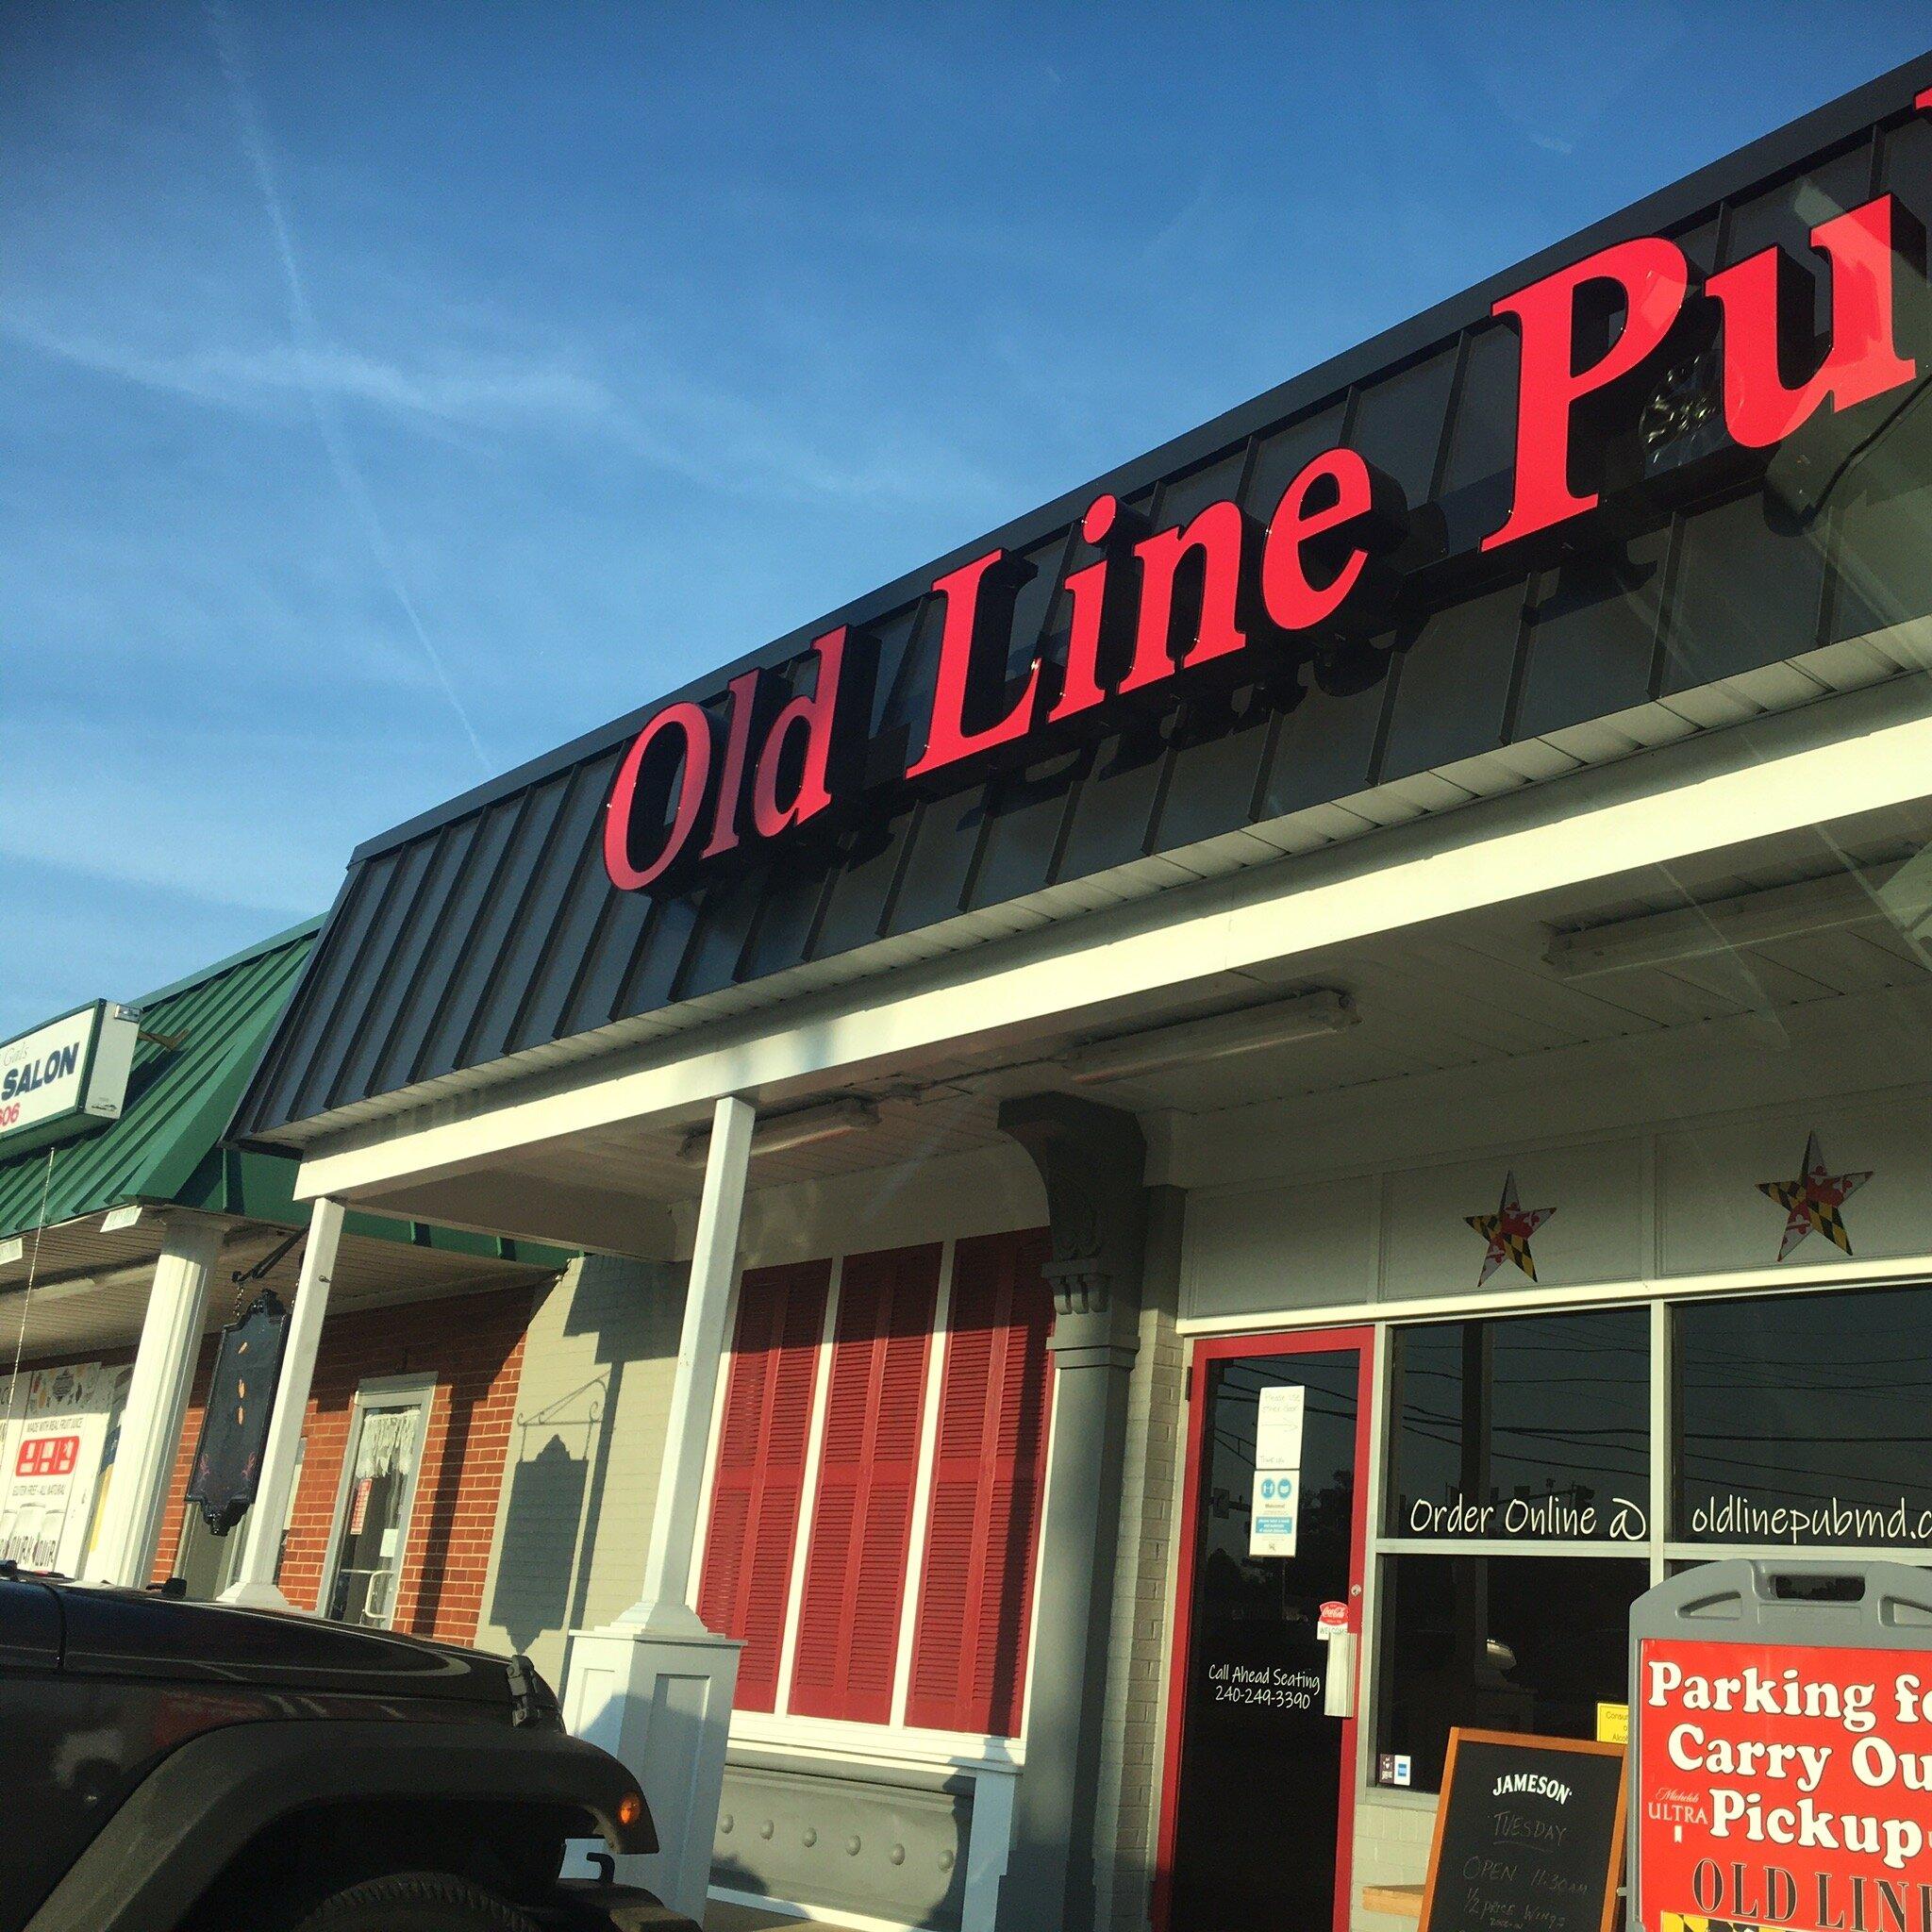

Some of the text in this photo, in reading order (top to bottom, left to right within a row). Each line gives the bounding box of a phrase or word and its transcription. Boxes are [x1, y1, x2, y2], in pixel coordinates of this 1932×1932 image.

[604, 87, 1932, 891] Old Line Pu
[1, 1041, 80, 1102] SALON
[1410, 1493, 1493, 1533] Order
[1505, 1495, 1596, 1536] Online
[1609, 1497, 1646, 1541] @
[1208, 1663, 1321, 1696] Call Ahead Seating
[1215, 1685, 1311, 1709] 240-249-3390
[1648, 1659, 1876, 1733] Parking
[1606, 1711, 1628, 1721] Consu
[1667, 1723, 1834, 1792] Carry
[1492, 1774, 1571, 1806] JAMESON
[1493, 1810, 1567, 1846] TUESDAY
[1647, 1801, 1708, 1825] ULTRA
[1708, 1788, 1924, 1870] Pickup
[1462, 1855, 1518, 1881] OPEN
[1692, 1857, 1798, 1923] OLD
